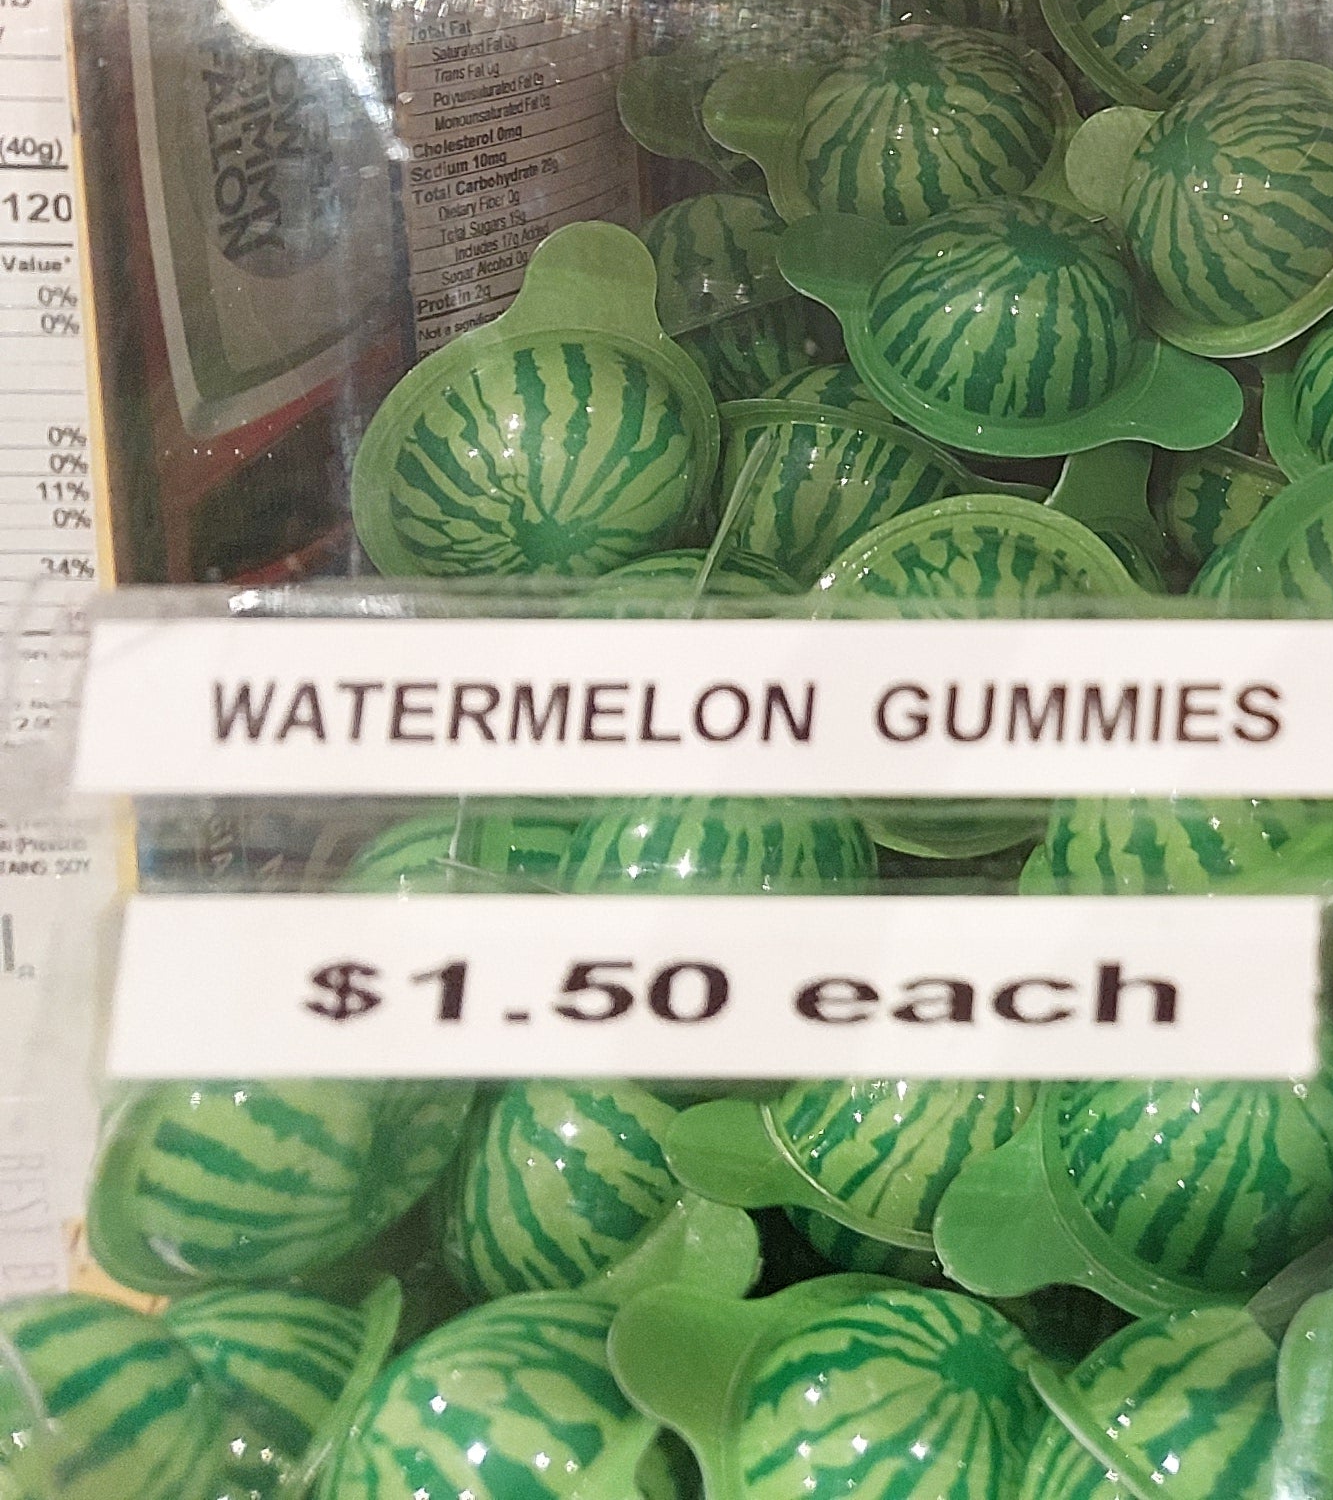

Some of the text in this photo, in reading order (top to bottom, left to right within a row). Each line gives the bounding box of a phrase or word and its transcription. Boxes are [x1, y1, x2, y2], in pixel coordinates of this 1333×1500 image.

[410, 19, 472, 42] Total Fat
[432, 41, 484, 62] Saturated
[434, 65, 466, 83] Trans
[434, 103, 524, 132] Monounsaturated
[411, 125, 523, 159] Cholesterol 0mg
[410, 151, 508, 183] Sodium 10mg
[410, 185, 451, 206] Total
[455, 163, 539, 197] Carbohydrate
[4, 192, 73, 224] 120
[469, 214, 507, 237] Sugars
[476, 252, 514, 277] Alcohol
[37, 284, 78, 307] 0%
[417, 289, 471, 316] Protein
[40, 312, 80, 335] 0%
[48, 426, 87, 447] 0%
[50, 453, 89, 474] 0%
[37, 481, 90, 501] 11%
[53, 507, 92, 529] 0%
[213, 681, 1283, 744] WATERMELON GUMMIES
[304, 960, 1178, 1027] $1.50 each
